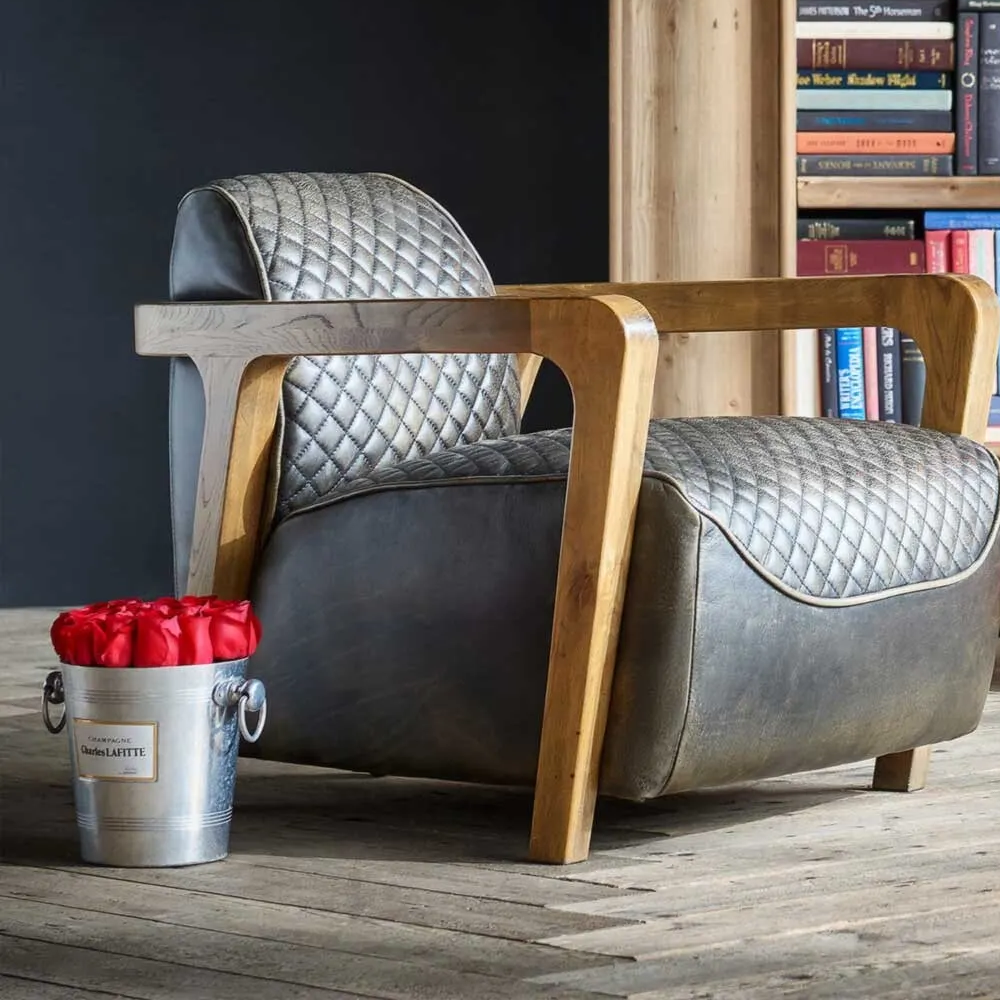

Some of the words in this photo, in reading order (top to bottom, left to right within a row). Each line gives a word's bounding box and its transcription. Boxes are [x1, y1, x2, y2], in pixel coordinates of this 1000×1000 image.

[853, 6, 868, 16] The
[883, 6, 923, 17] Horseman
[88, 736, 133, 744] CHAMPAGNE
[80, 744, 106, 757] Charles
[106, 747, 147, 758] LAFITTE
